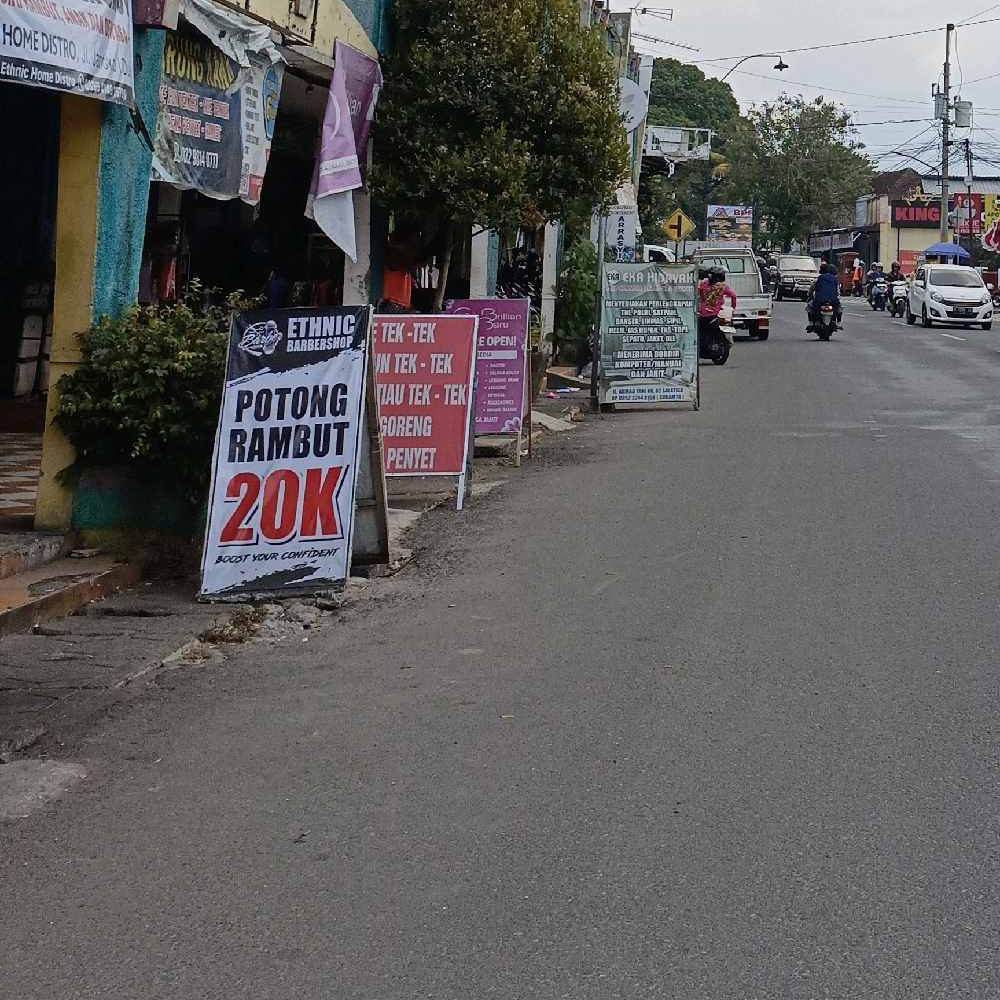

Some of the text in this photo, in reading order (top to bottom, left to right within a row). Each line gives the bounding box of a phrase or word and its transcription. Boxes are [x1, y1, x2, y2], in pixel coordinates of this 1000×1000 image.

[3, 24, 38, 50] HOME
[1, 61, 29, 80] Ethnic
[31, 66, 54, 84] Home
[896, 207, 940, 221] KING
[622, 272, 694, 283] EKA HIDAYAH
[480, 307, 522, 322] Brillian
[481, 317, 509, 331] Baru
[287, 314, 356, 338] ETHNIC
[381, 323, 405, 343] TEK
[286, 336, 354, 352] BARBERSHOP
[487, 336, 517, 346] OPEN!
[394, 353, 418, 374] TEK
[430, 353, 454, 374] TEK
[615, 360, 682, 368] KOMPUTER/MANUAL
[630, 370, 645, 378] DAN
[235, 383, 348, 423] POTONG
[408, 384, 432, 406] TEK
[444, 384, 467, 405] TEK
[380, 416, 433, 437] GORENG
[227, 422, 350, 463] RAMBUT
[387, 447, 437, 470] PENYET
[219, 465, 346, 545] 20K
[214, 553, 252, 565] BOOST
[252, 552, 279, 561] YOUR
